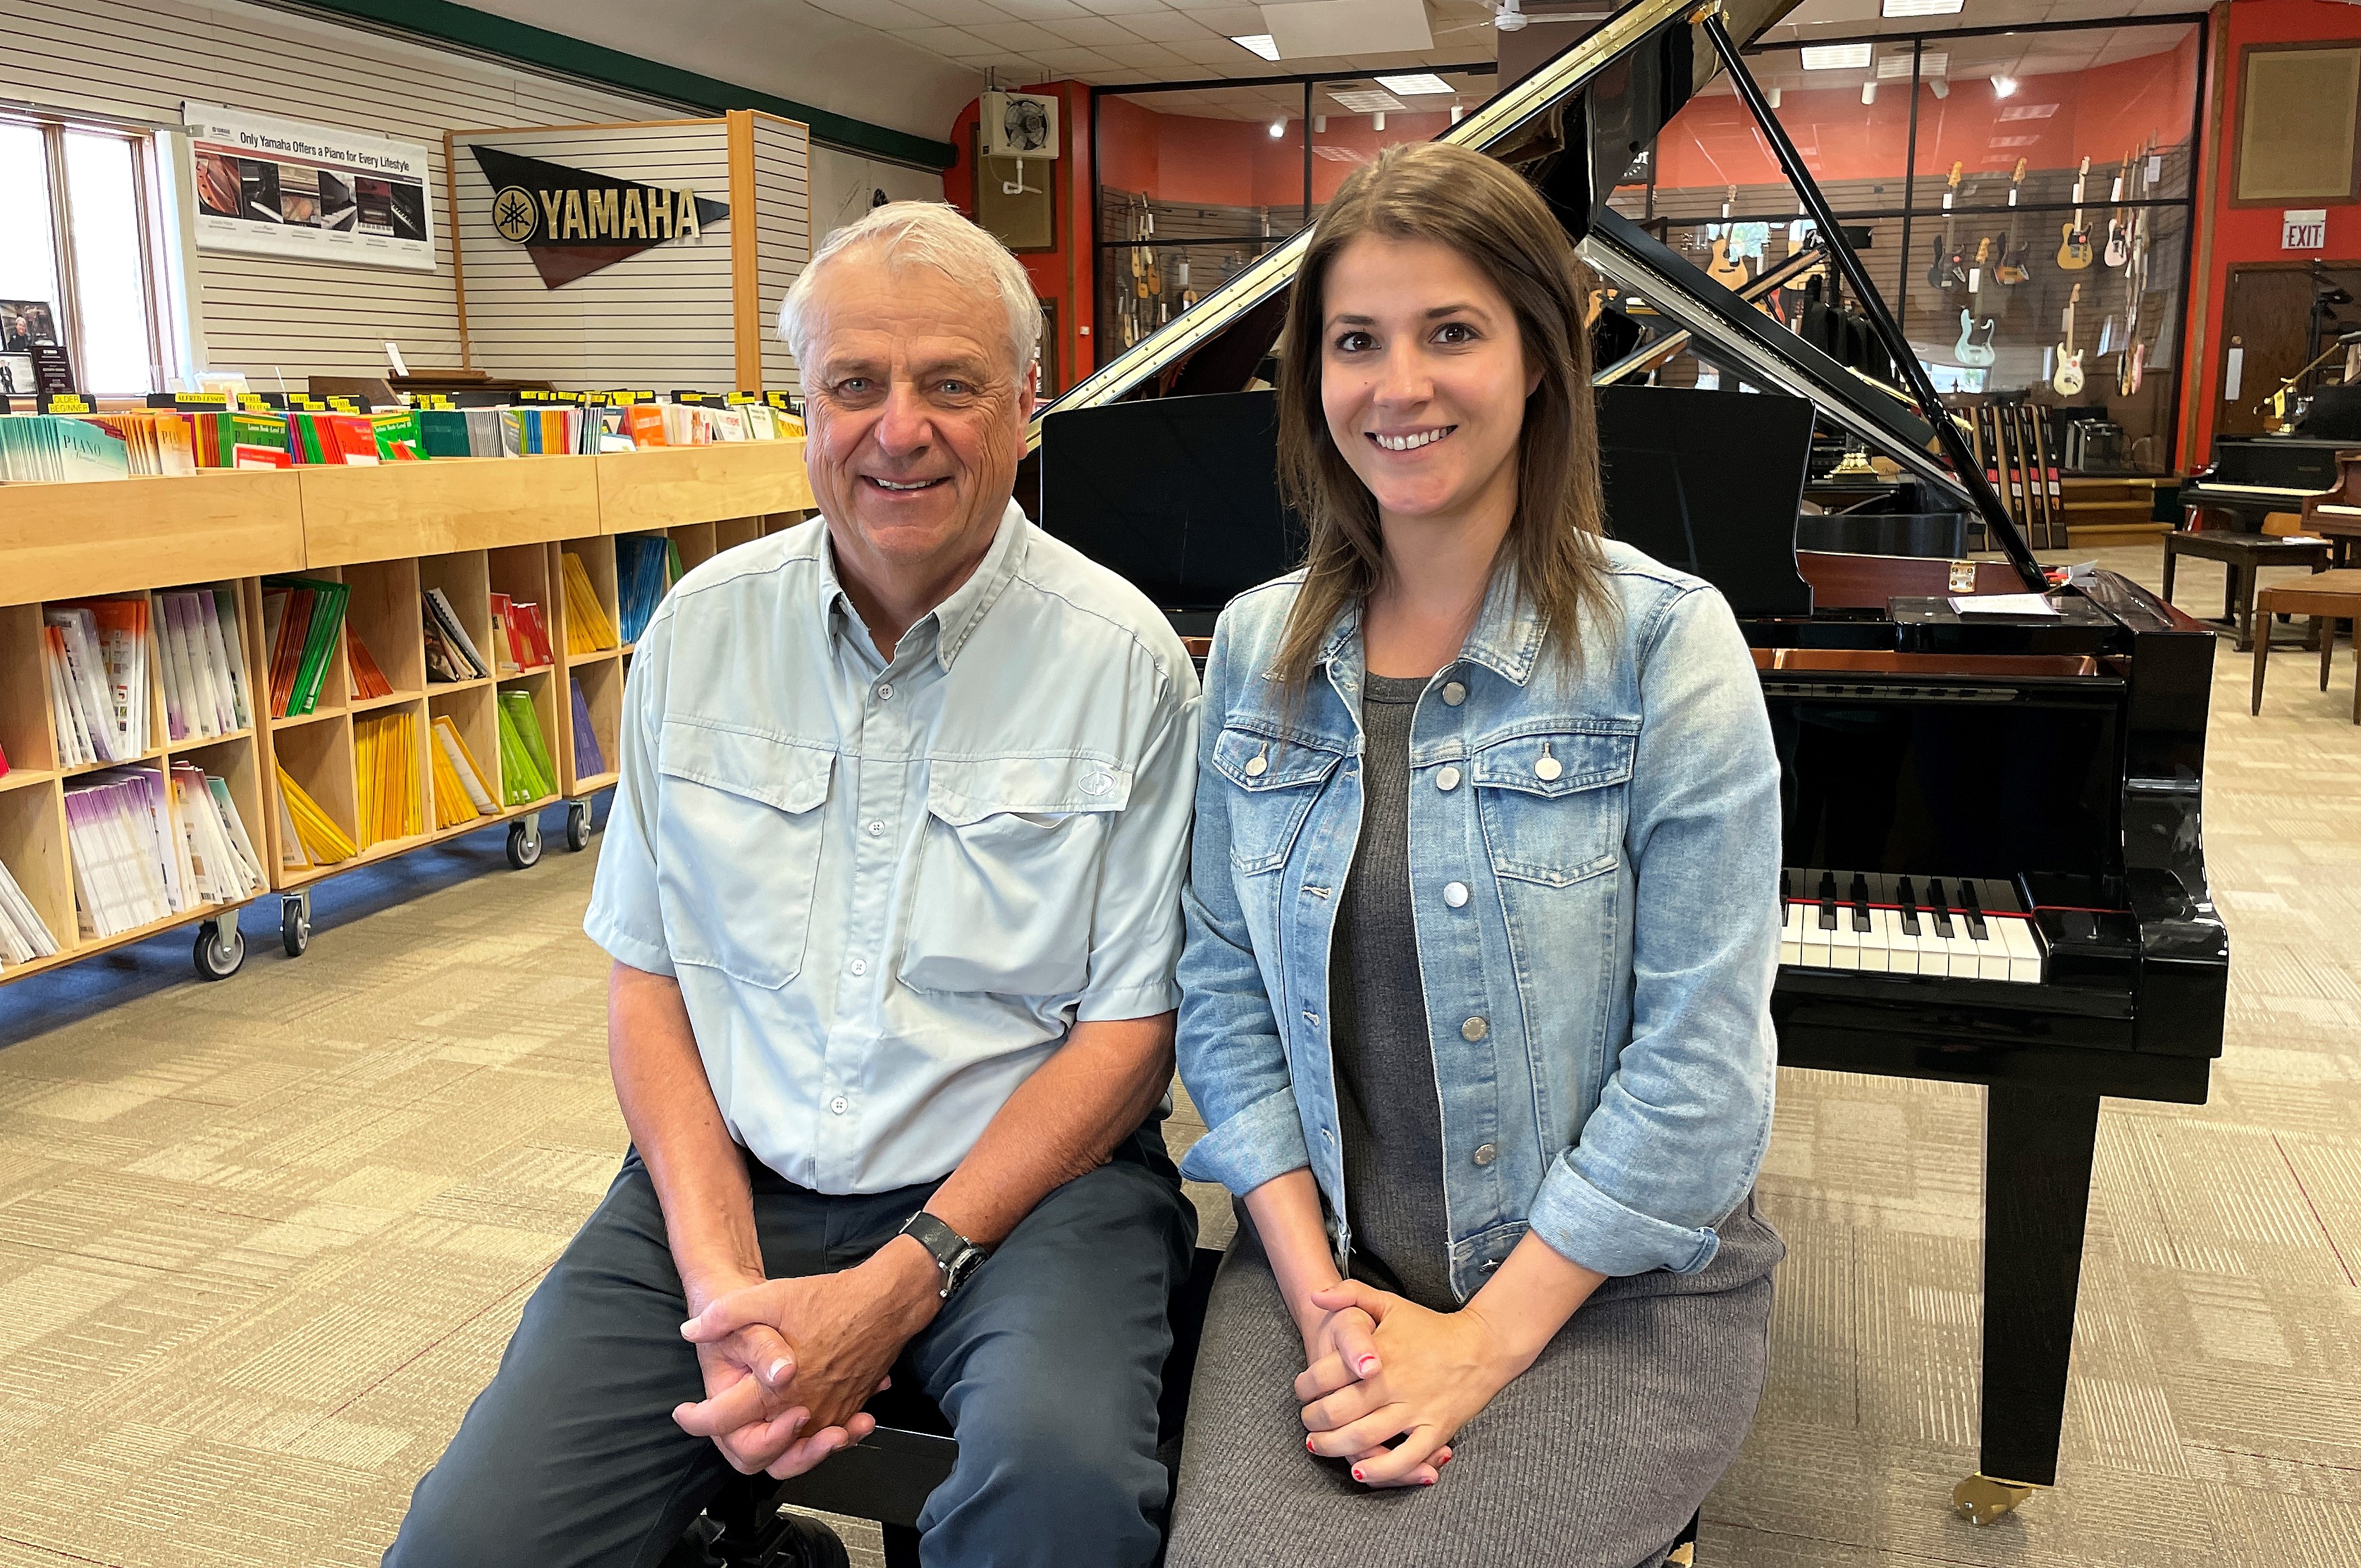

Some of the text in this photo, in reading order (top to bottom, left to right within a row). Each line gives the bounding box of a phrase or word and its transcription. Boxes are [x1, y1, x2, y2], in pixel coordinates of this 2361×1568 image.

[240, 132, 409, 172] Only Yamaha Offers a Piano for Every Lifestyle
[539, 188, 701, 240] YAMAHA
[2288, 225, 2322, 246] EXIT
[50, 404, 88, 412] BEGINNER
[63, 435, 101, 457] PIANO
